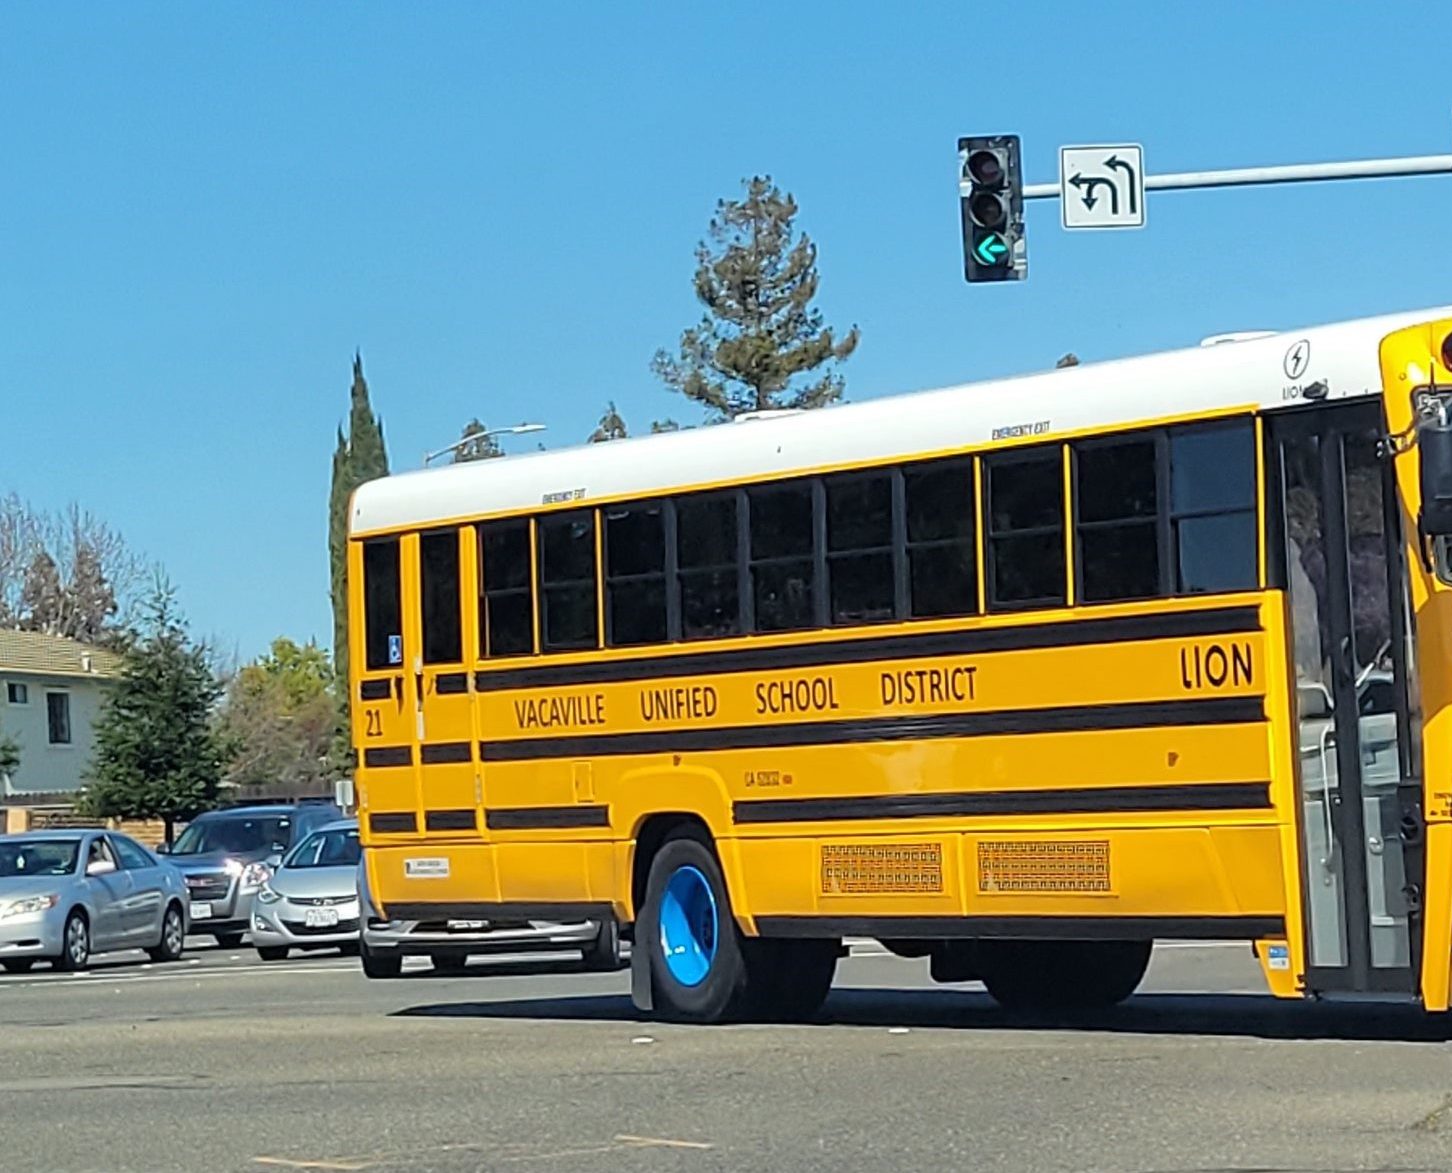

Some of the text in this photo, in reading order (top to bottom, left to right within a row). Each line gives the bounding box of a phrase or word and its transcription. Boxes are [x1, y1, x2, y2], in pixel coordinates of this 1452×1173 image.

[1282, 384, 1303, 400] LIO
[992, 424, 1032, 440] EMERGENCY
[1181, 642, 1252, 689] LION
[515, 666, 977, 728] VACAVILLE UNIFIED SCHOOL DISTRICT
[366, 709, 383, 737] 21
